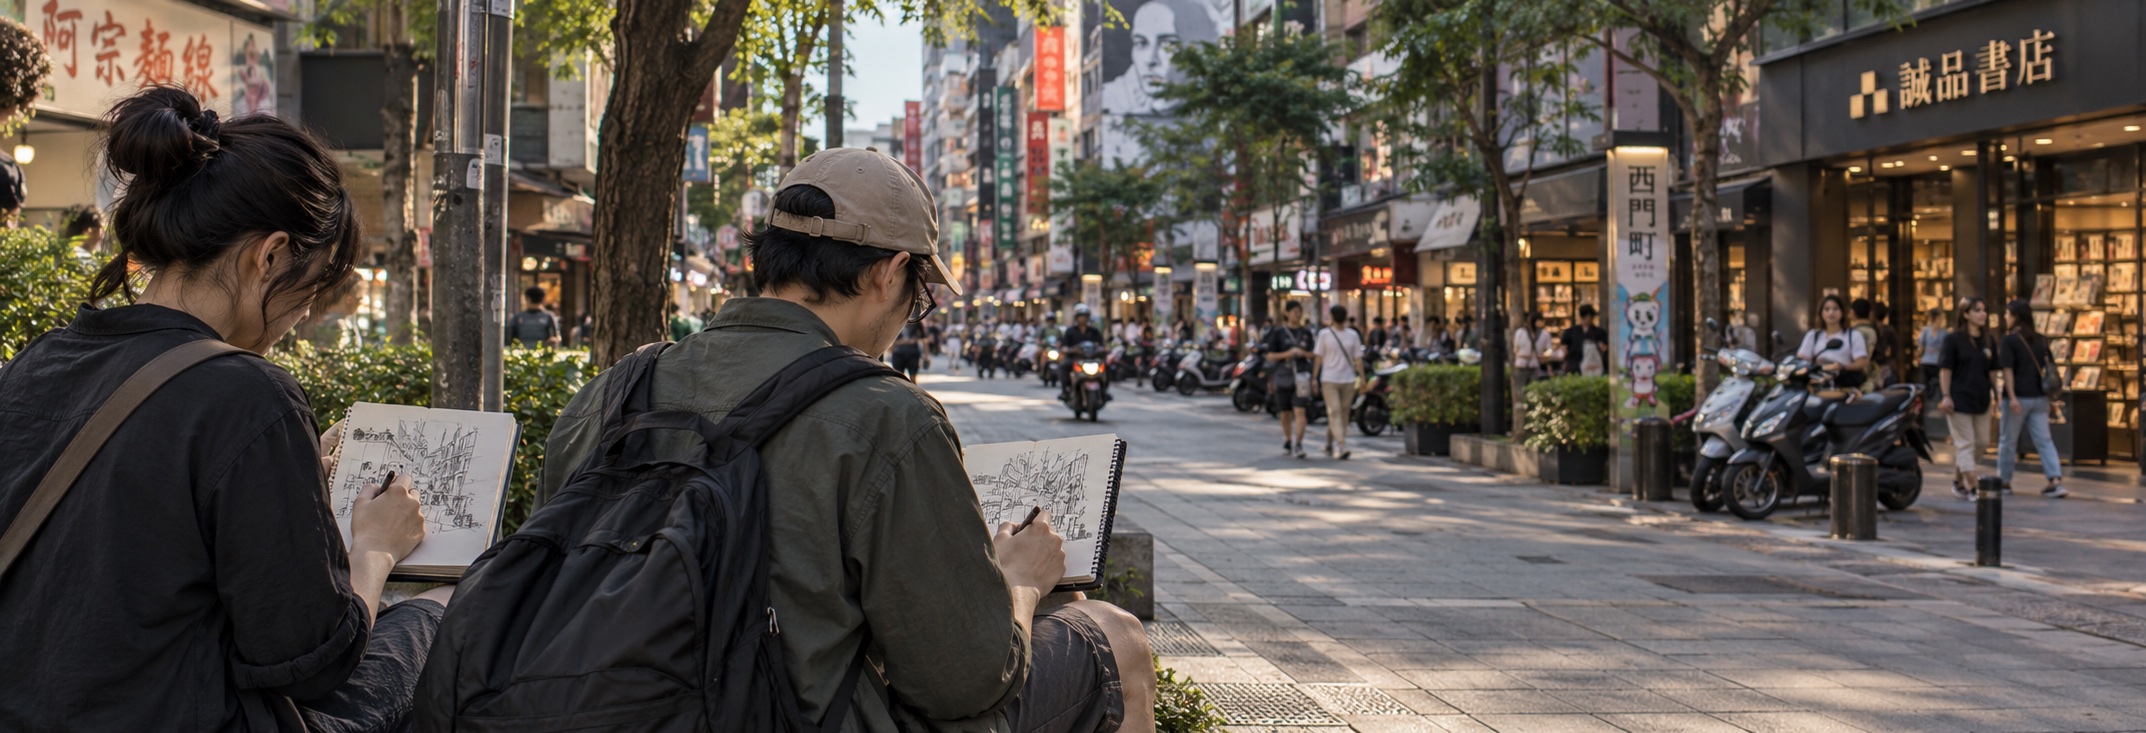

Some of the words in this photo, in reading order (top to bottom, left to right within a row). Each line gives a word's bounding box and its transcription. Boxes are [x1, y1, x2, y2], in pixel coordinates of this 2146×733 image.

[42, 0, 218, 103] 阿宗麵線
[1898, 28, 2055, 110] 誠品書店
[1628, 165, 1657, 261] 西門町
